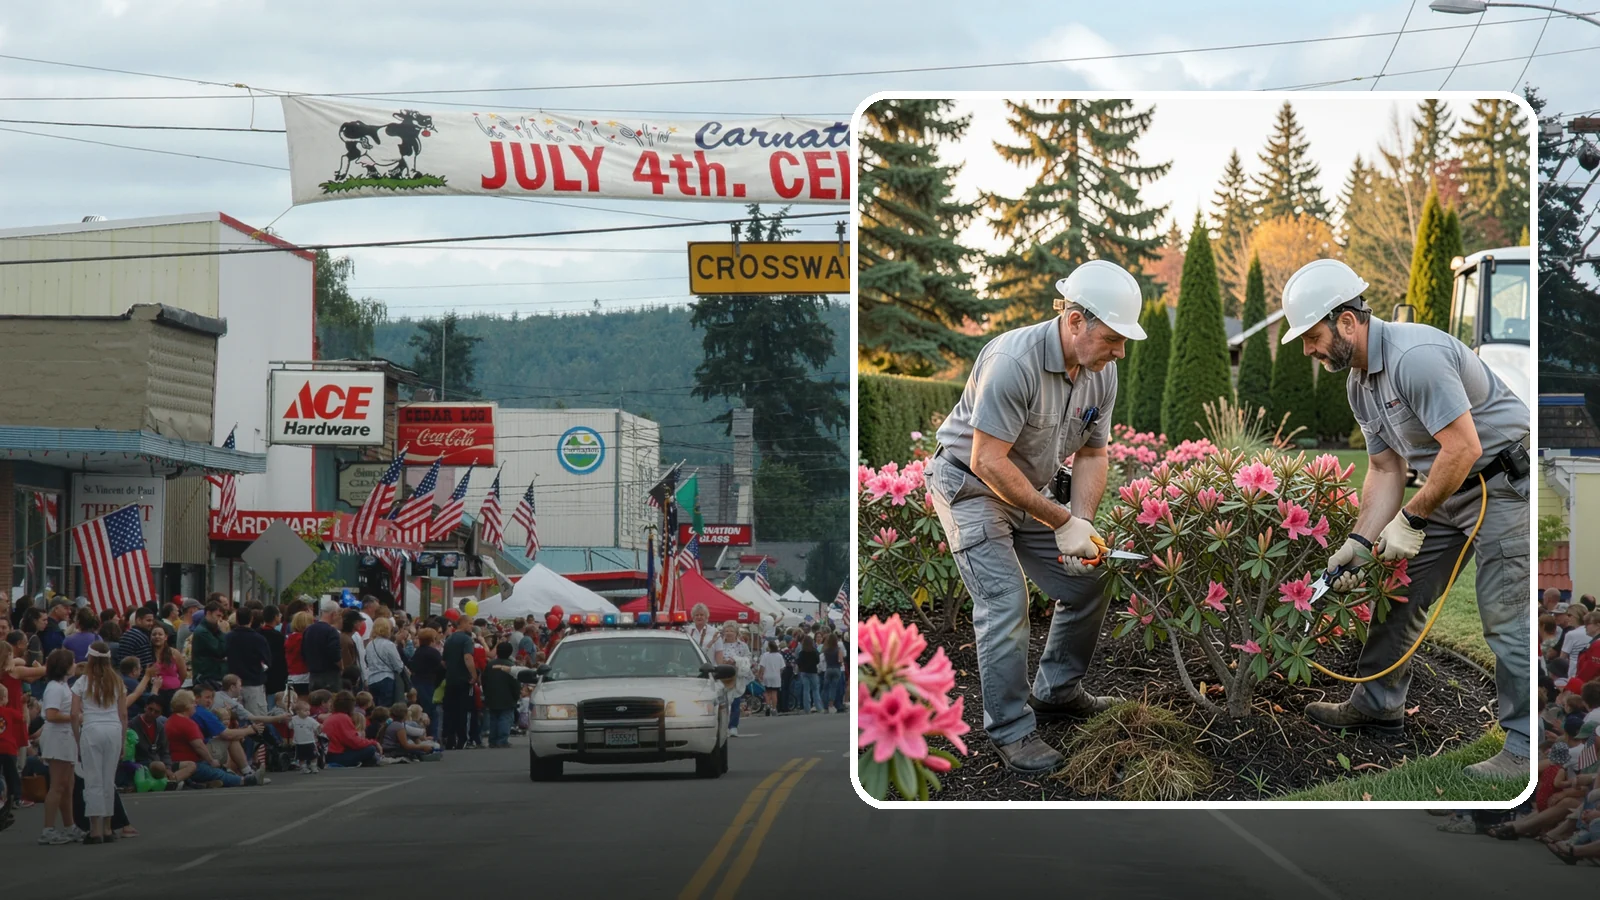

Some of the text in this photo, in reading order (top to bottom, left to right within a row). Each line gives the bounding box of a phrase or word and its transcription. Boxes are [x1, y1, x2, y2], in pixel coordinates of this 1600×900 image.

[481, 140, 605, 193] JULY
[632, 150, 746, 198] 4th.
[697, 254, 850, 280] CROSSWA
[283, 380, 374, 420] ACE
[405, 409, 485, 422] CEDAR LOG
[283, 421, 371, 437] Hardware
[416, 428, 477, 447] Coca-Cola
[83, 485, 155, 495] St. Vincent de Paul
[688, 526, 741, 535] CRNATION
[699, 535, 730, 543] GLASS
